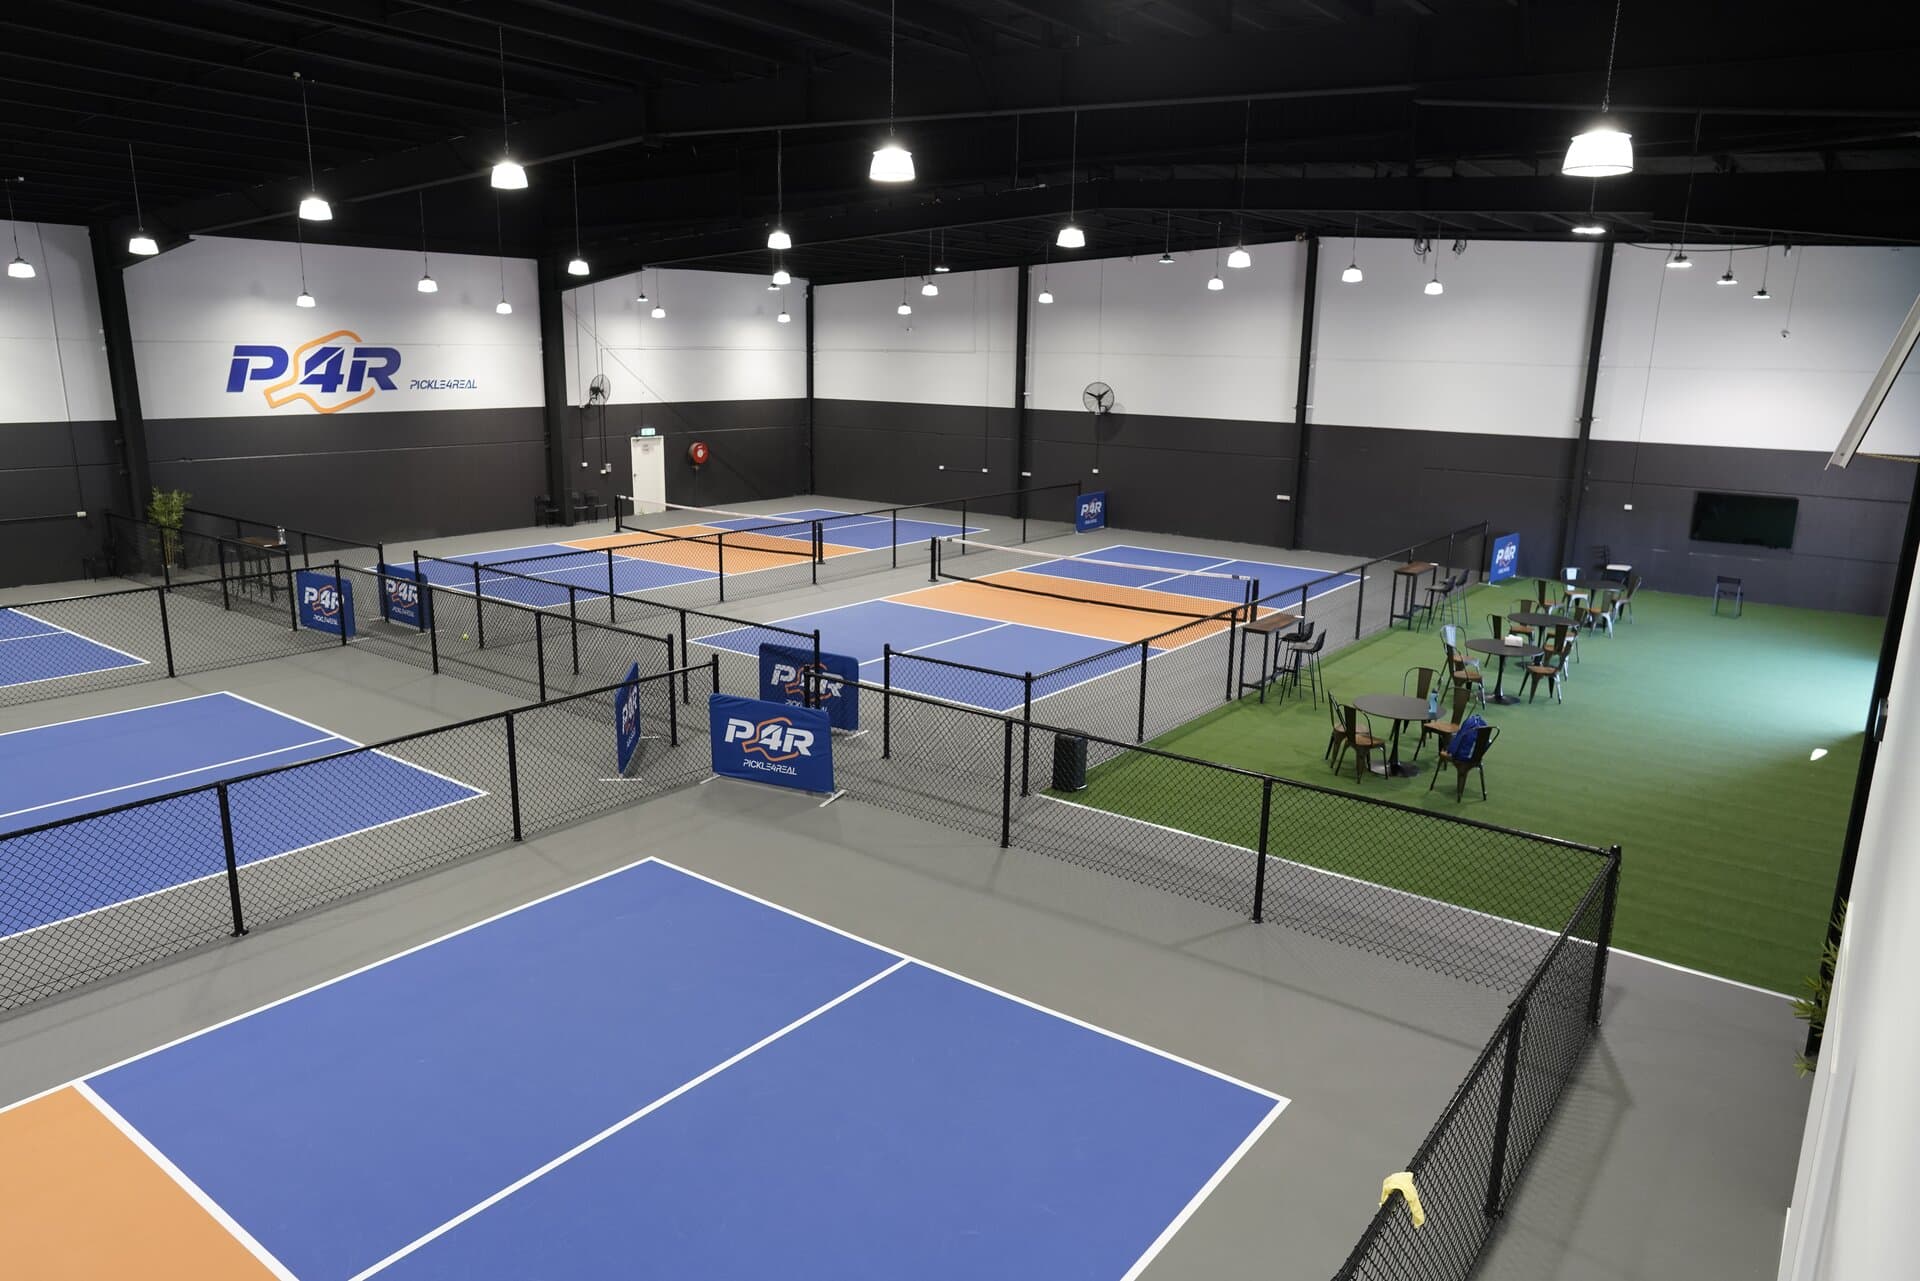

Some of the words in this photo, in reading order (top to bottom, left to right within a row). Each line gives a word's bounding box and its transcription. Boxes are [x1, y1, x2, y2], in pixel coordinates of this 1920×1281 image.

[226, 345, 401, 392] P4R
[410, 379, 477, 390] PICKLE4REAL
[725, 718, 814, 756] P4R
[743, 759, 797, 775] PICKLE4REAL
